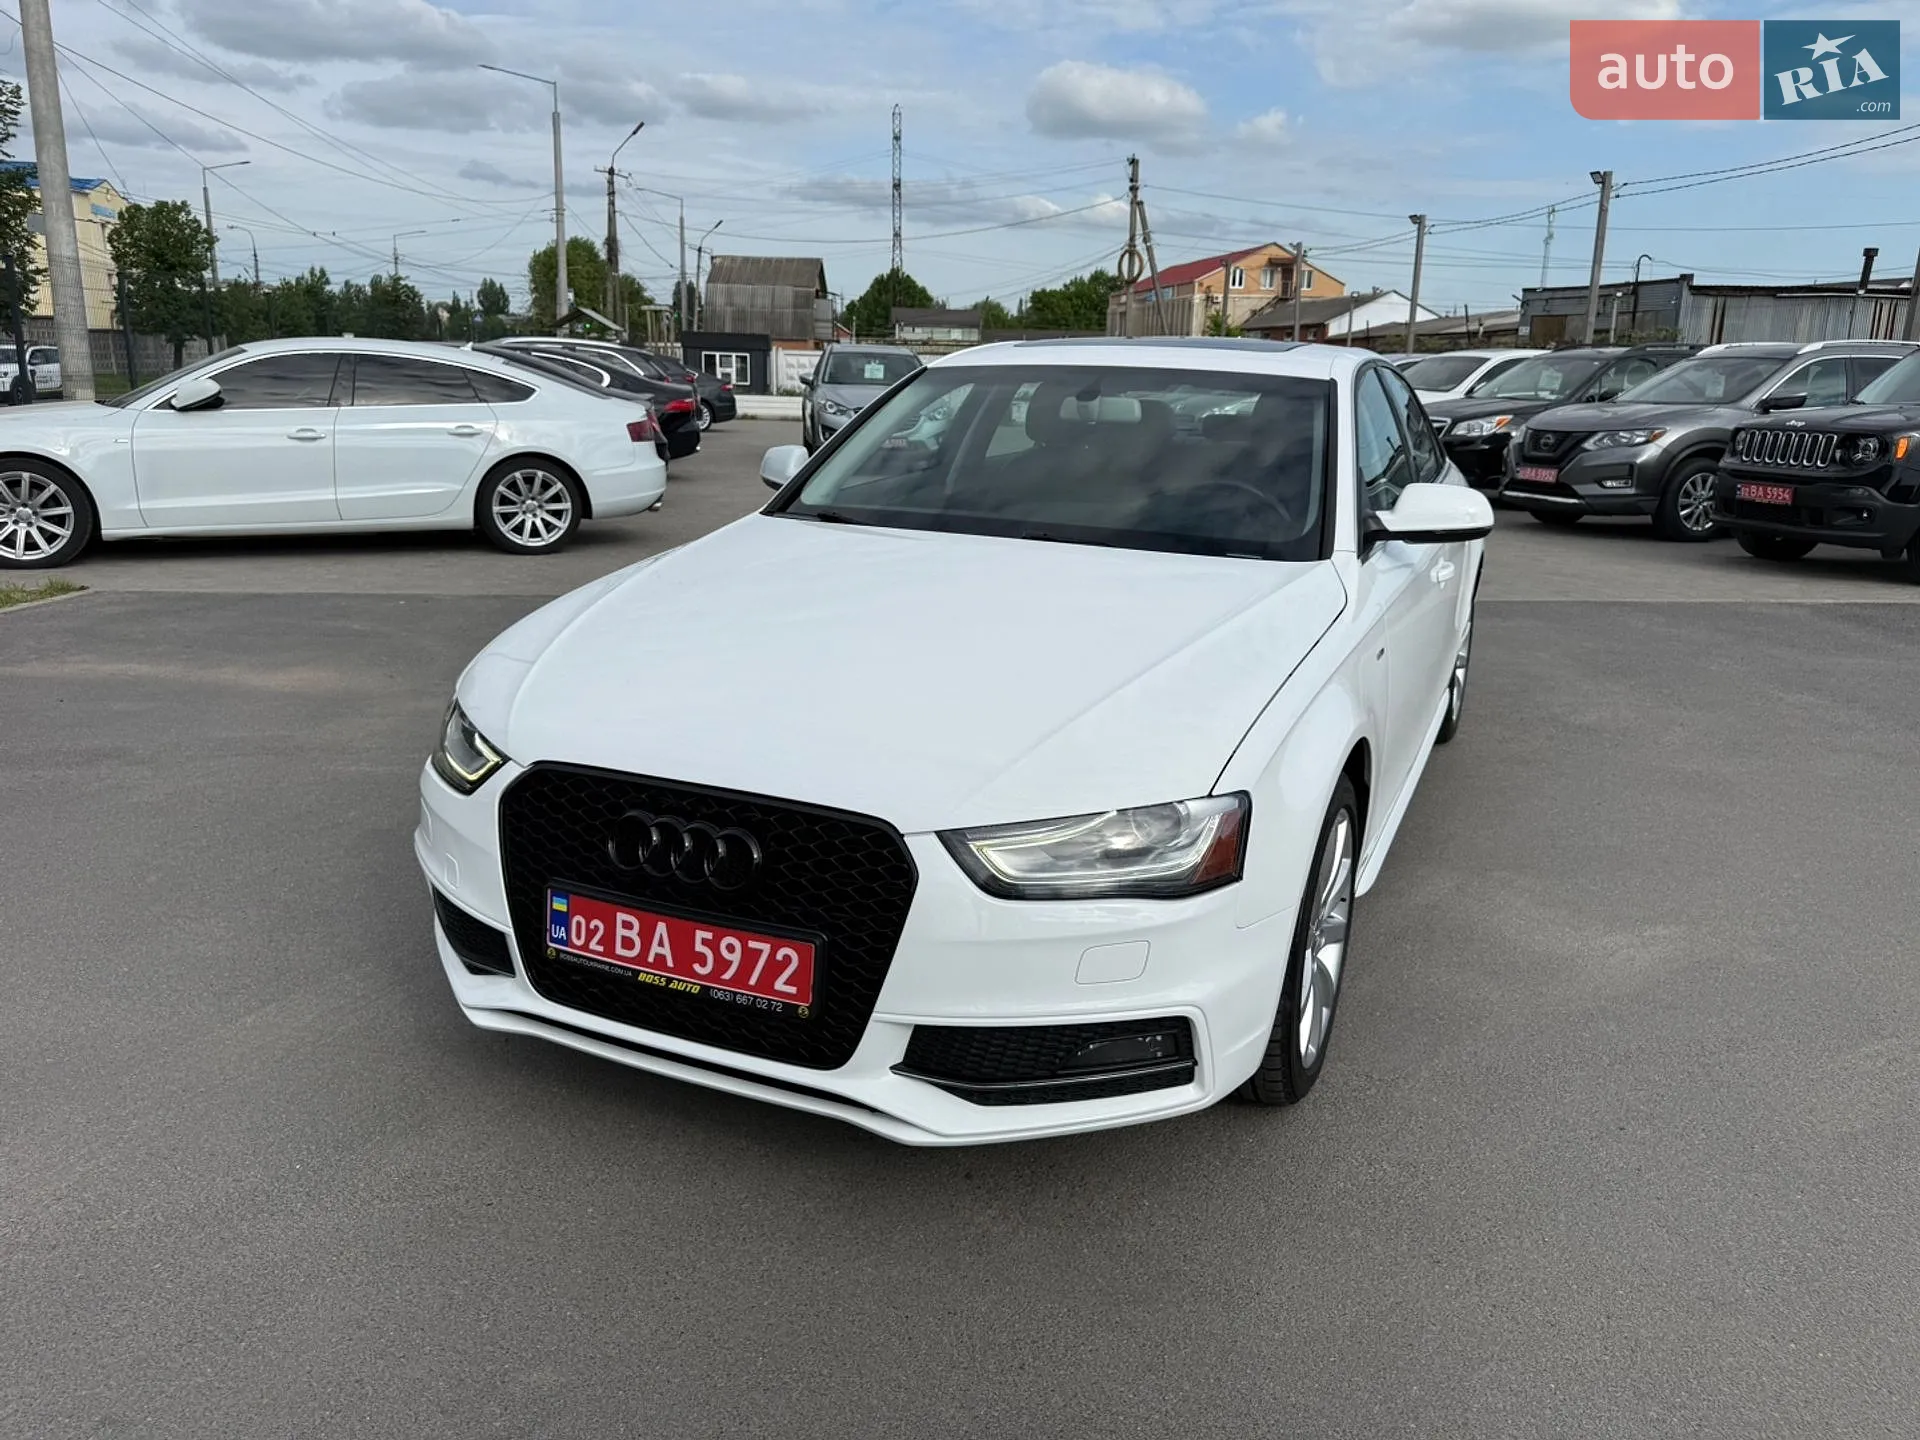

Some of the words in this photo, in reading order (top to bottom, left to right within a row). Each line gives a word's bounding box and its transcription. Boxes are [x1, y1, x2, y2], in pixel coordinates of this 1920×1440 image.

[551, 923, 567, 940] UA
[570, 914, 605, 952] 02
[615, 911, 675, 968] BA
[692, 928, 800, 995] 5972
[637, 971, 667, 987] BOSS
[668, 979, 701, 995] AUTO
[709, 988, 734, 1002] (063)
[735, 993, 754, 1006] 667
[755, 998, 769, 1010] 02
[770, 1001, 783, 1013] 72
